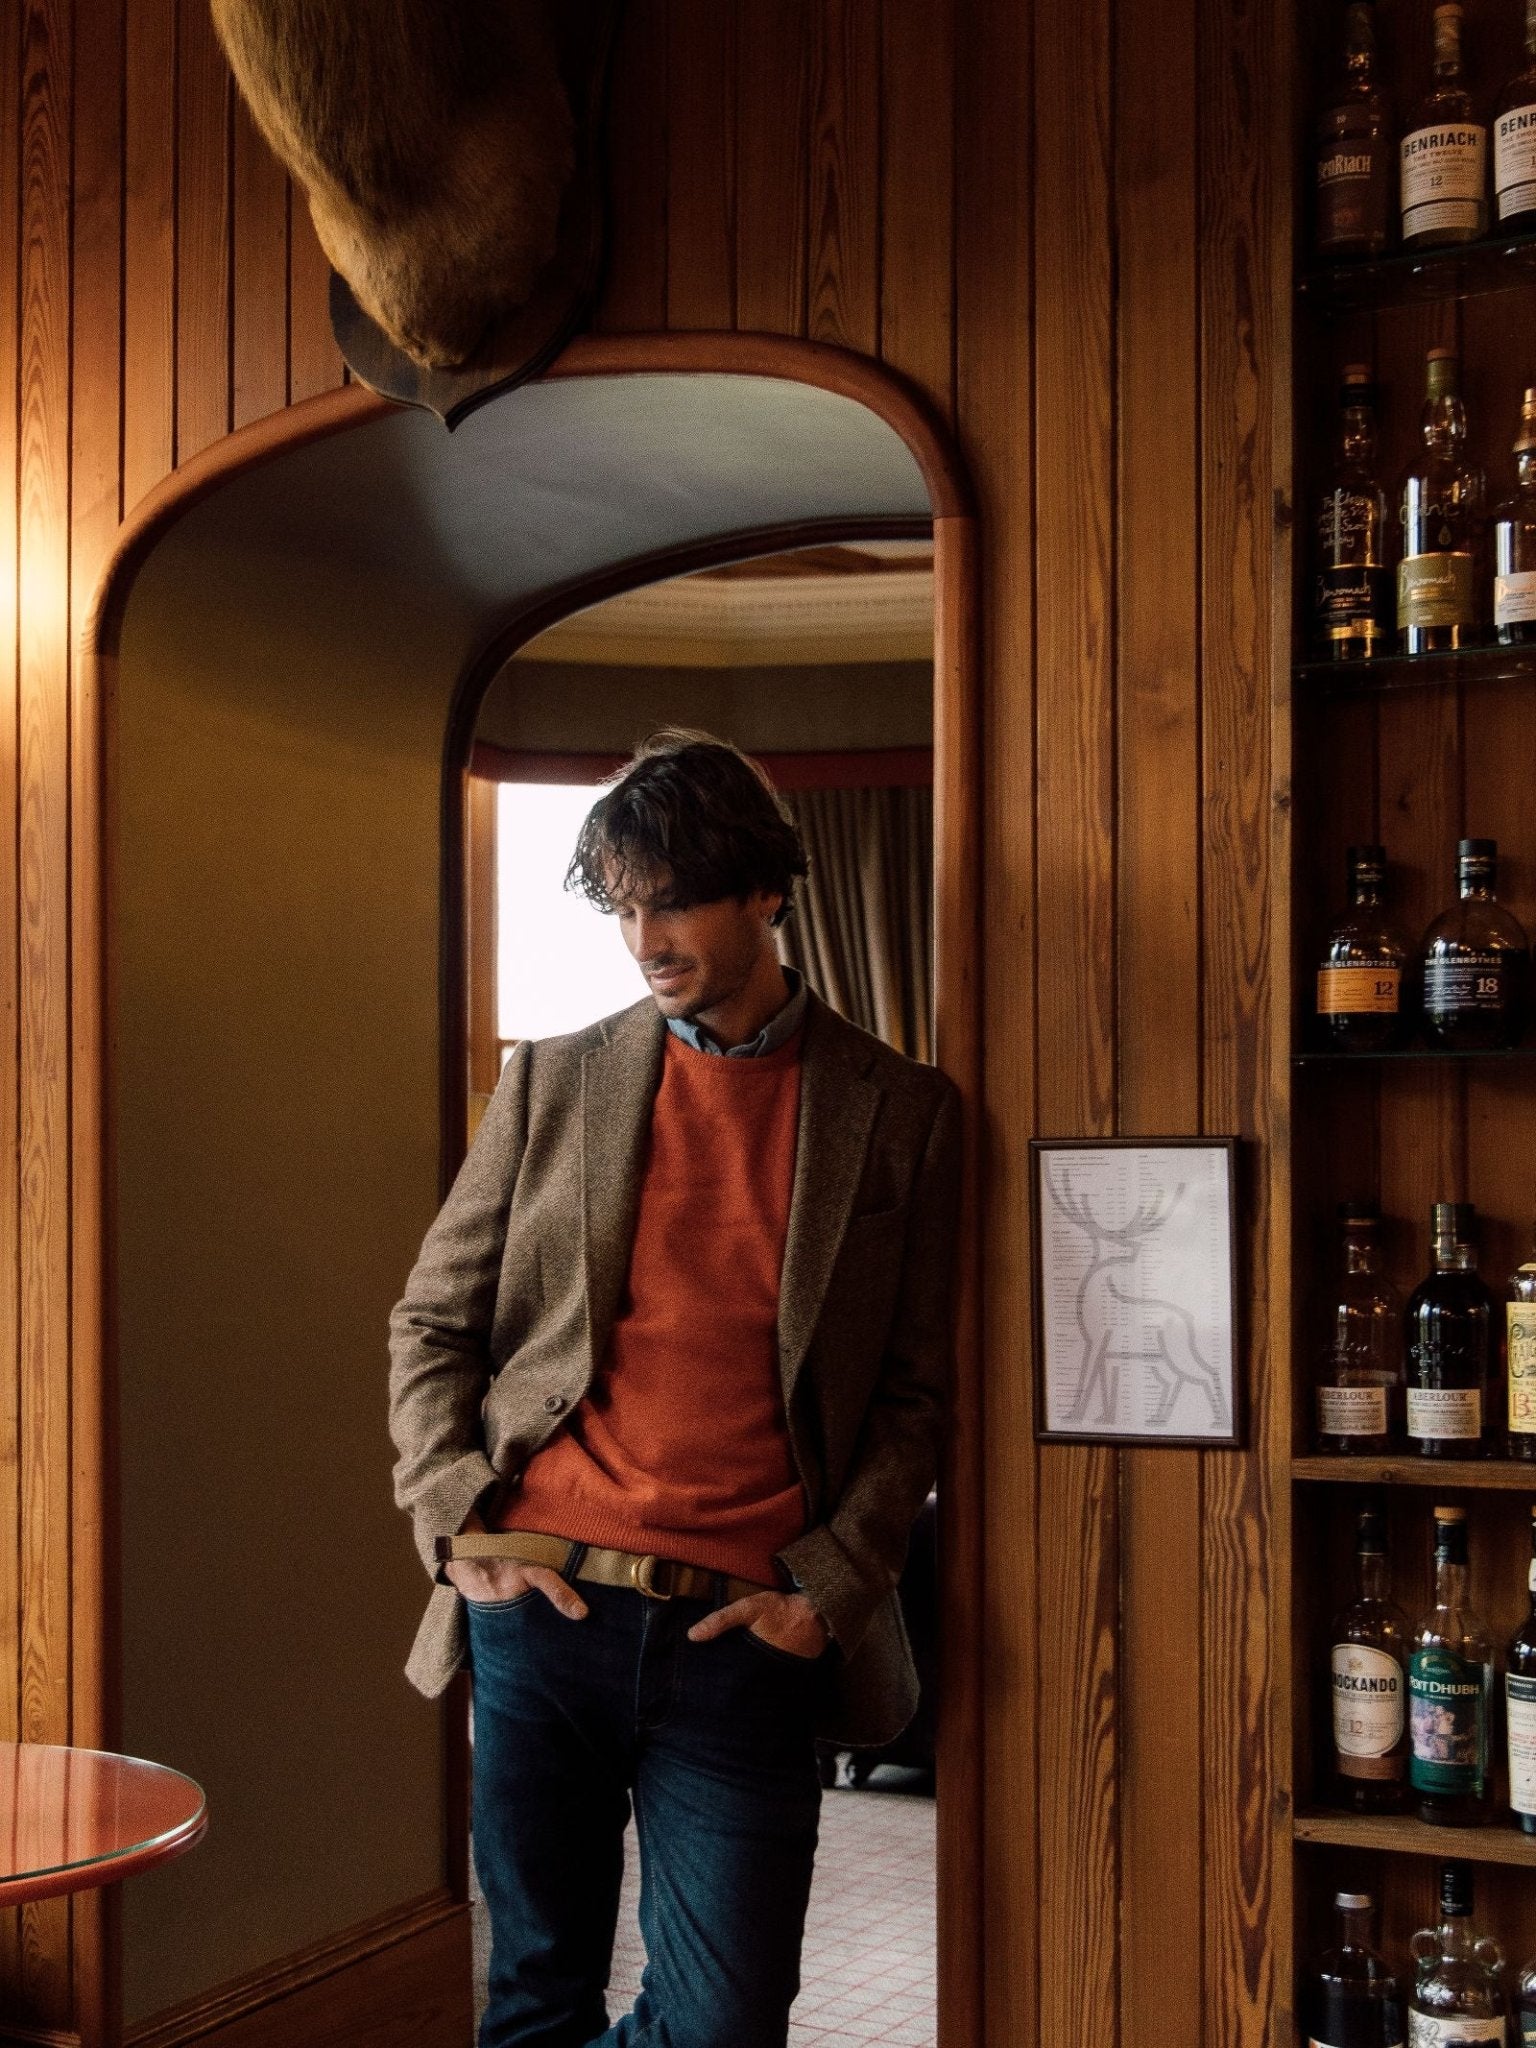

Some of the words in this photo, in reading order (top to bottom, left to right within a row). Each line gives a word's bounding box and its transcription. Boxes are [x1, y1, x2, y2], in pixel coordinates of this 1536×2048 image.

[1403, 132, 1477, 158] BENRIACH
[1430, 175, 1443, 187] 12
[1374, 981, 1393, 996] 12
[1476, 977, 1499, 993] 18
